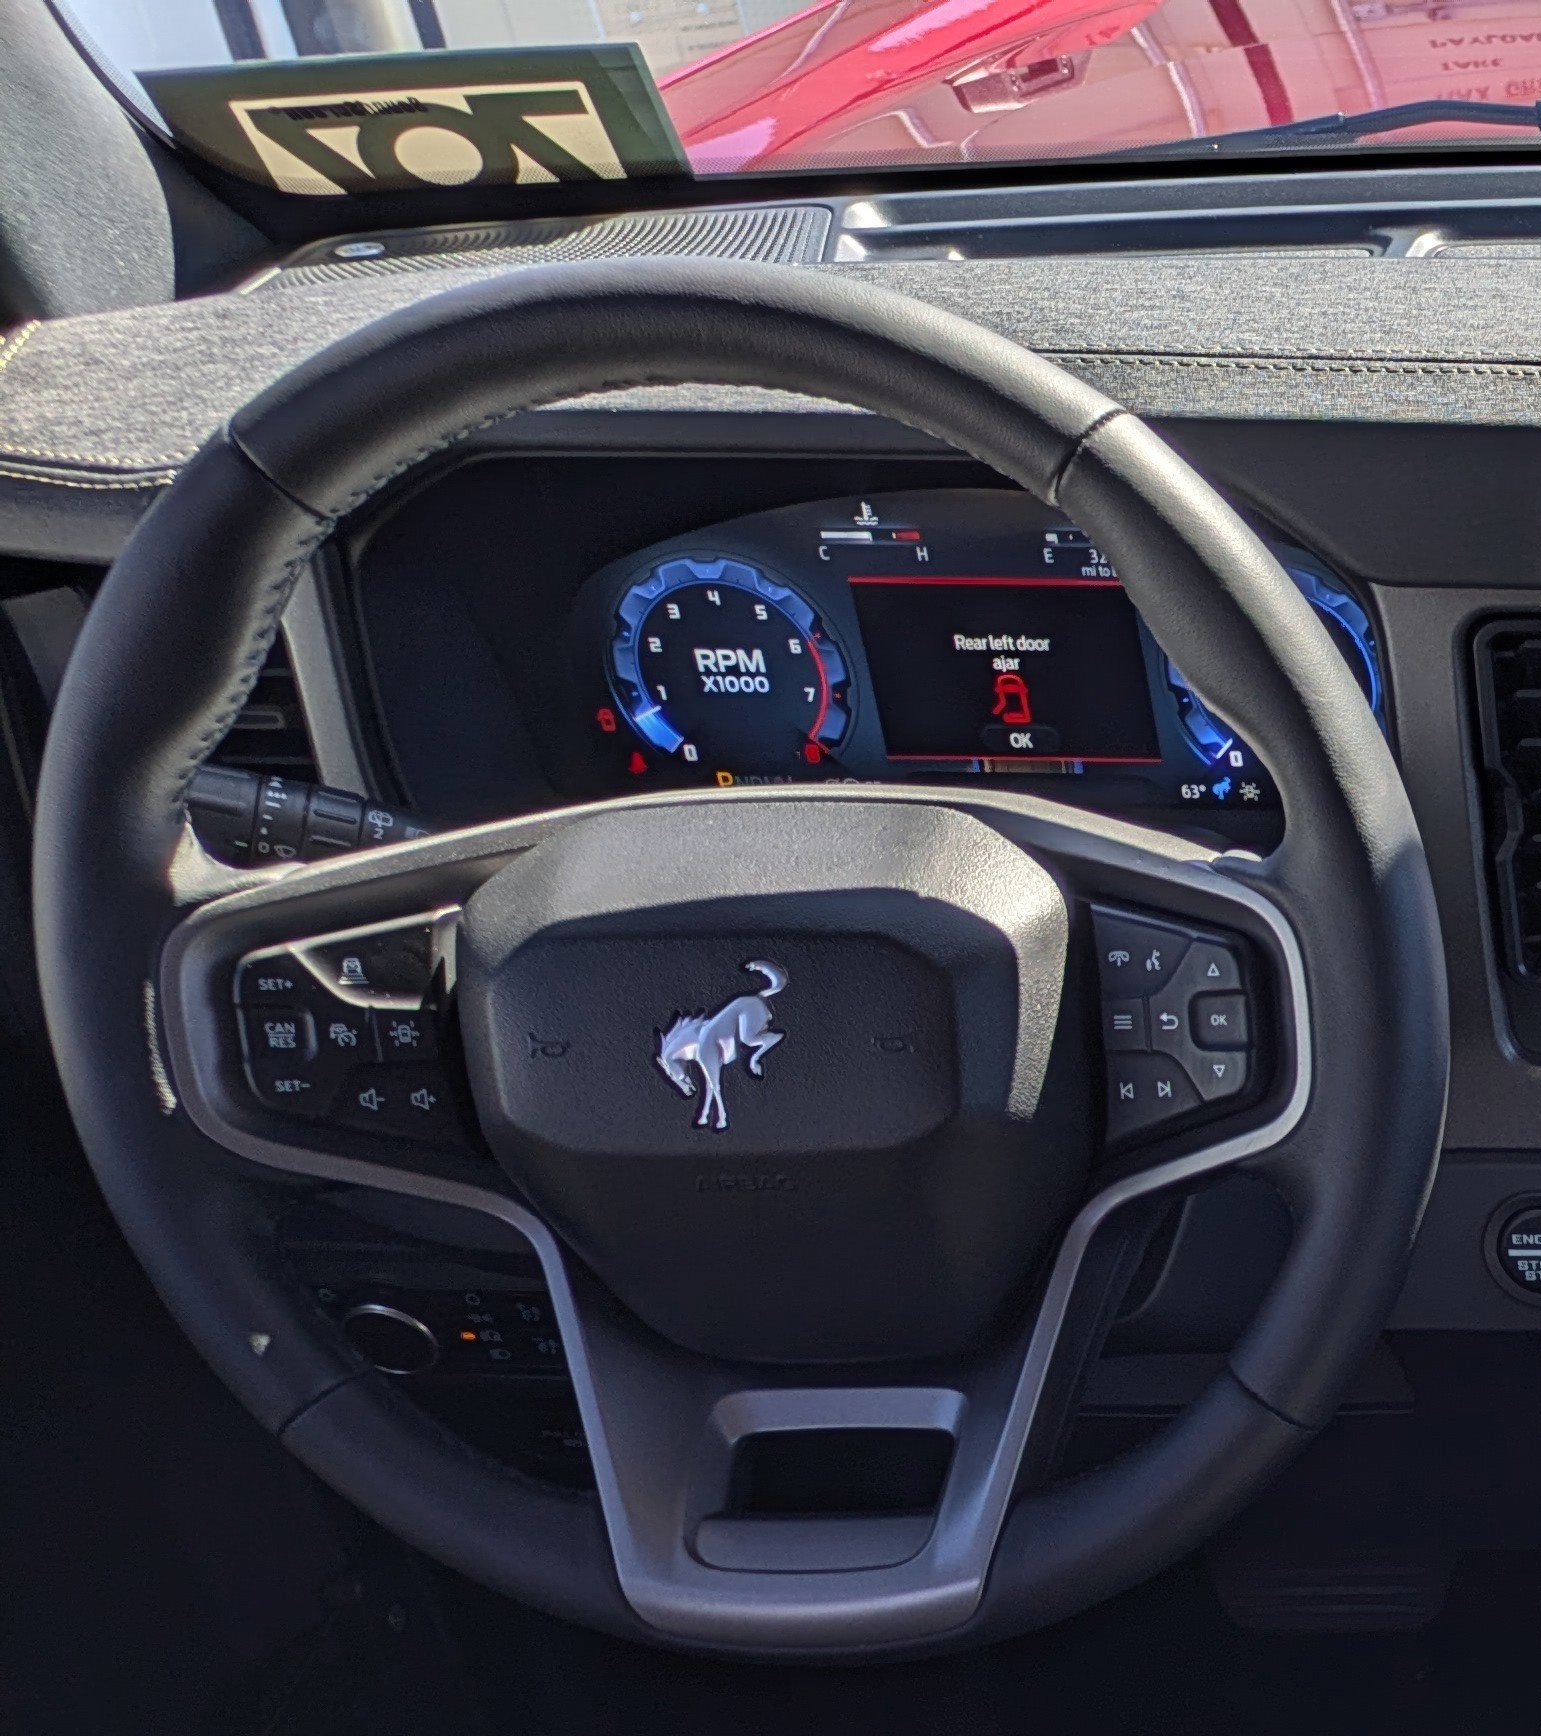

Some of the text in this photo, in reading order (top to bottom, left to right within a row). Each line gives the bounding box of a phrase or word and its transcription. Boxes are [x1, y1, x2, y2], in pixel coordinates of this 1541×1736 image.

[818, 545, 830, 561] C
[916, 547, 929, 562] H
[1043, 548, 1055, 563] E
[706, 589, 721, 606] 4
[666, 603, 681, 620] 3
[754, 604, 769, 621] 5
[648, 637, 662, 653] 2
[788, 638, 803, 654] 6
[953, 634, 1050, 651] Rear left door
[694, 648, 767, 674] RPM
[992, 656, 1020, 672] ajar
[701, 675, 770, 694] X1000
[657, 685, 668, 701] 1
[804, 687, 815, 702] 7
[1009, 732, 1033, 749] OK
[684, 743, 699, 762] 0
[1229, 750, 1244, 767] 0
[258, 977, 293, 991] SET+
[1210, 1014, 1228, 1026] OK
[264, 1022, 296, 1035] CAN
[267, 1037, 297, 1049] RES
